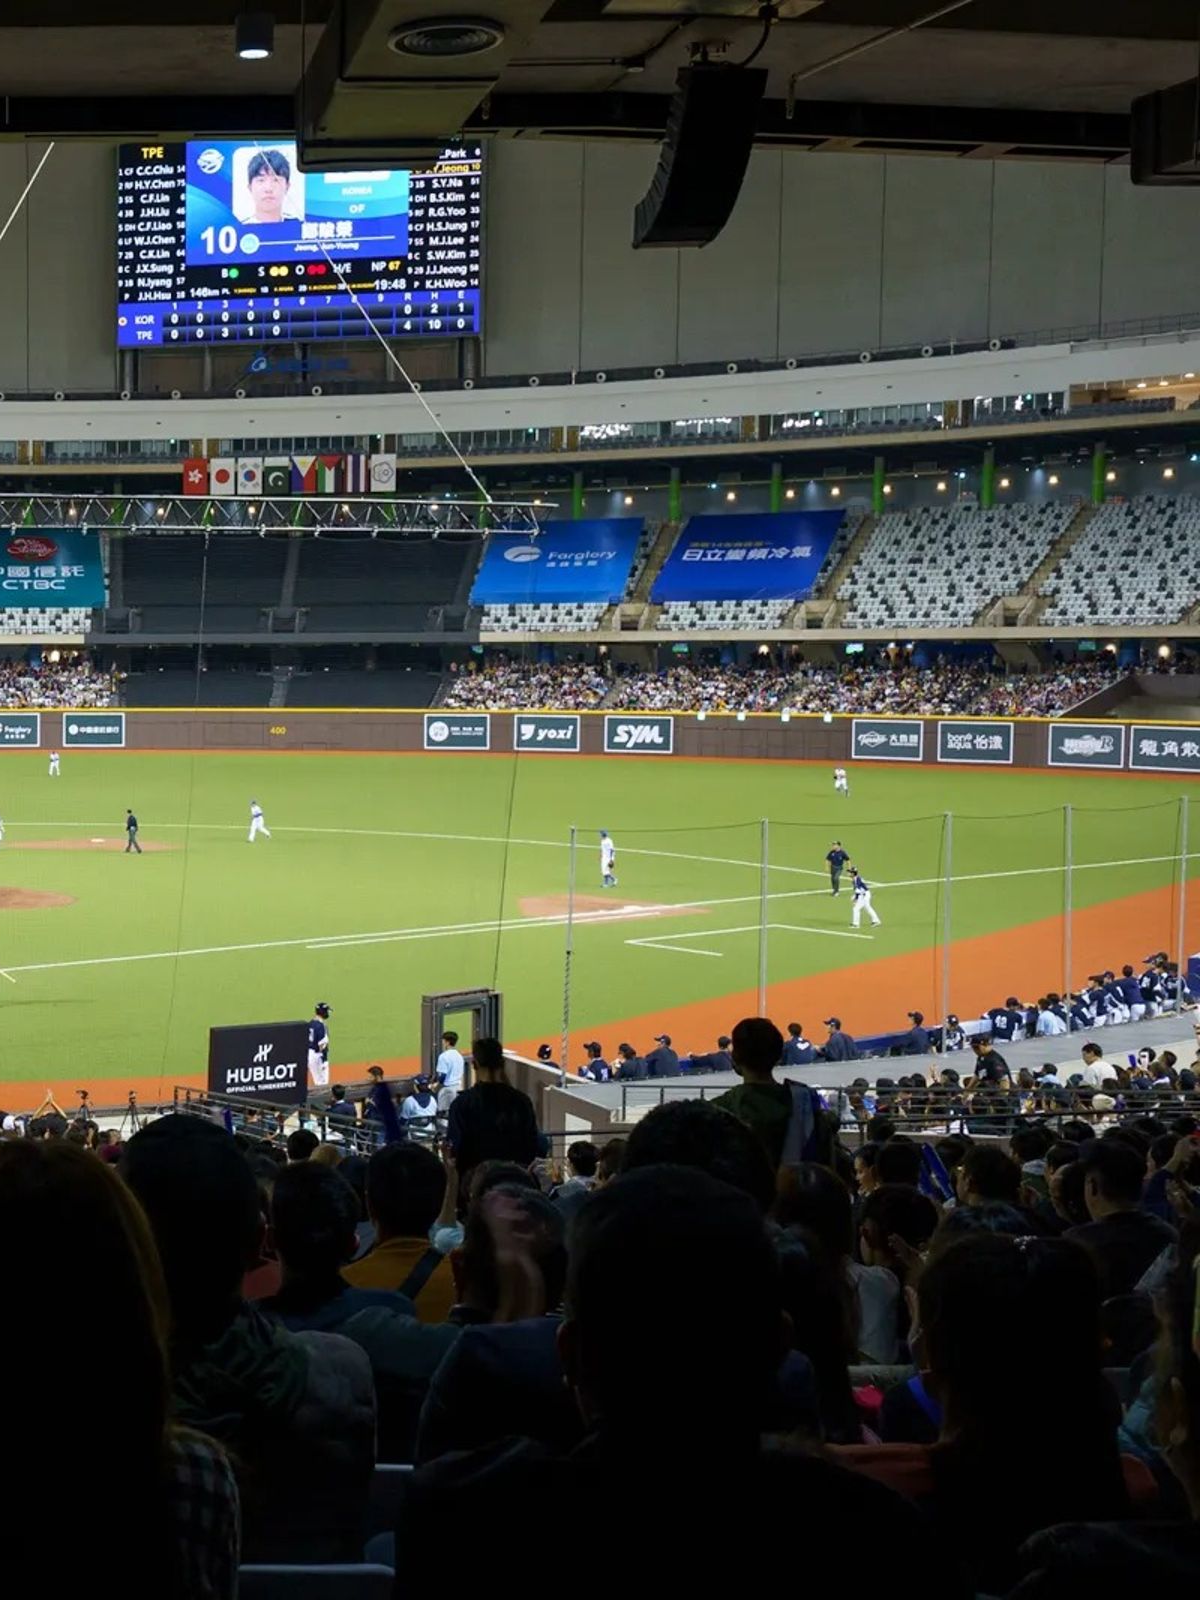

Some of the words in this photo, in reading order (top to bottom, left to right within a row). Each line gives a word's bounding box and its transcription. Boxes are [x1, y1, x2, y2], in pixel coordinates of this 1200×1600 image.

[141, 146, 164, 159] TPE
[135, 179, 176, 190] H.Y.Chen
[432, 178, 463, 189] S.Y.Na
[430, 192, 465, 203] B.S.Kim
[140, 207, 170, 218] J.H.Liu
[349, 204, 366, 214] OF
[429, 206, 467, 217] R.G.Yoo
[137, 221, 172, 232] C.F.Liao
[426, 221, 468, 233] H.S.Jung
[134, 235, 176, 246] W.J.Chen
[200, 225, 238, 254] 10
[429, 235, 465, 246] M.J.Lee
[139, 249, 170, 259] C.K.Lin
[427, 250, 466, 260] S.W.Kim
[135, 263, 174, 274] J.X.Sung
[295, 265, 305, 275] O
[371, 260, 386, 271] NP
[388, 260, 401, 271] 67
[426, 264, 467, 276] J.J.Jeong
[221, 268, 228, 278] B
[258, 266, 265, 277] S
[374, 278, 406, 291] 19:48
[425, 278, 467, 289] K.H.Woo
[138, 291, 172, 301] J.H.Hsu
[172, 302, 177, 310] 1
[197, 301, 203, 309] 2
[222, 300, 228, 308] 3
[248, 299, 253, 307] 4
[325, 296, 331, 304] 7
[404, 292, 412, 301] R
[431, 291, 438, 300] H
[457, 290, 464, 299] E
[135, 315, 154, 325] KOR
[171, 313, 178, 324] 0
[196, 312, 204, 323] 0
[222, 311, 229, 322] 0
[247, 310, 254, 321] 0
[272, 309, 280, 320] 0
[404, 304, 412, 315] 0
[431, 303, 438, 313] 2
[458, 302, 464, 312] 1
[136, 330, 153, 340] TPE
[171, 329, 178, 340] 0
[196, 328, 204, 339] 0
[222, 327, 229, 338] 3
[248, 326, 254, 336] 1
[272, 325, 280, 336] 0
[404, 319, 411, 330] 4
[428, 318, 441, 329] 10
[457, 317, 465, 328] 0
[548, 551, 617, 561] Farglory
[2, 579, 66, 590] CTBC
[269, 726, 287, 735] 400
[536, 725, 574, 741] yoxi
[613, 725, 665, 748] SYM
[1139, 738, 1200, 757] 龍角散
[226, 1063, 298, 1084] HUBLOT
[226, 1086, 257, 1094] OFFICIAL
[258, 1081, 297, 1092] TIMEKEEPER
